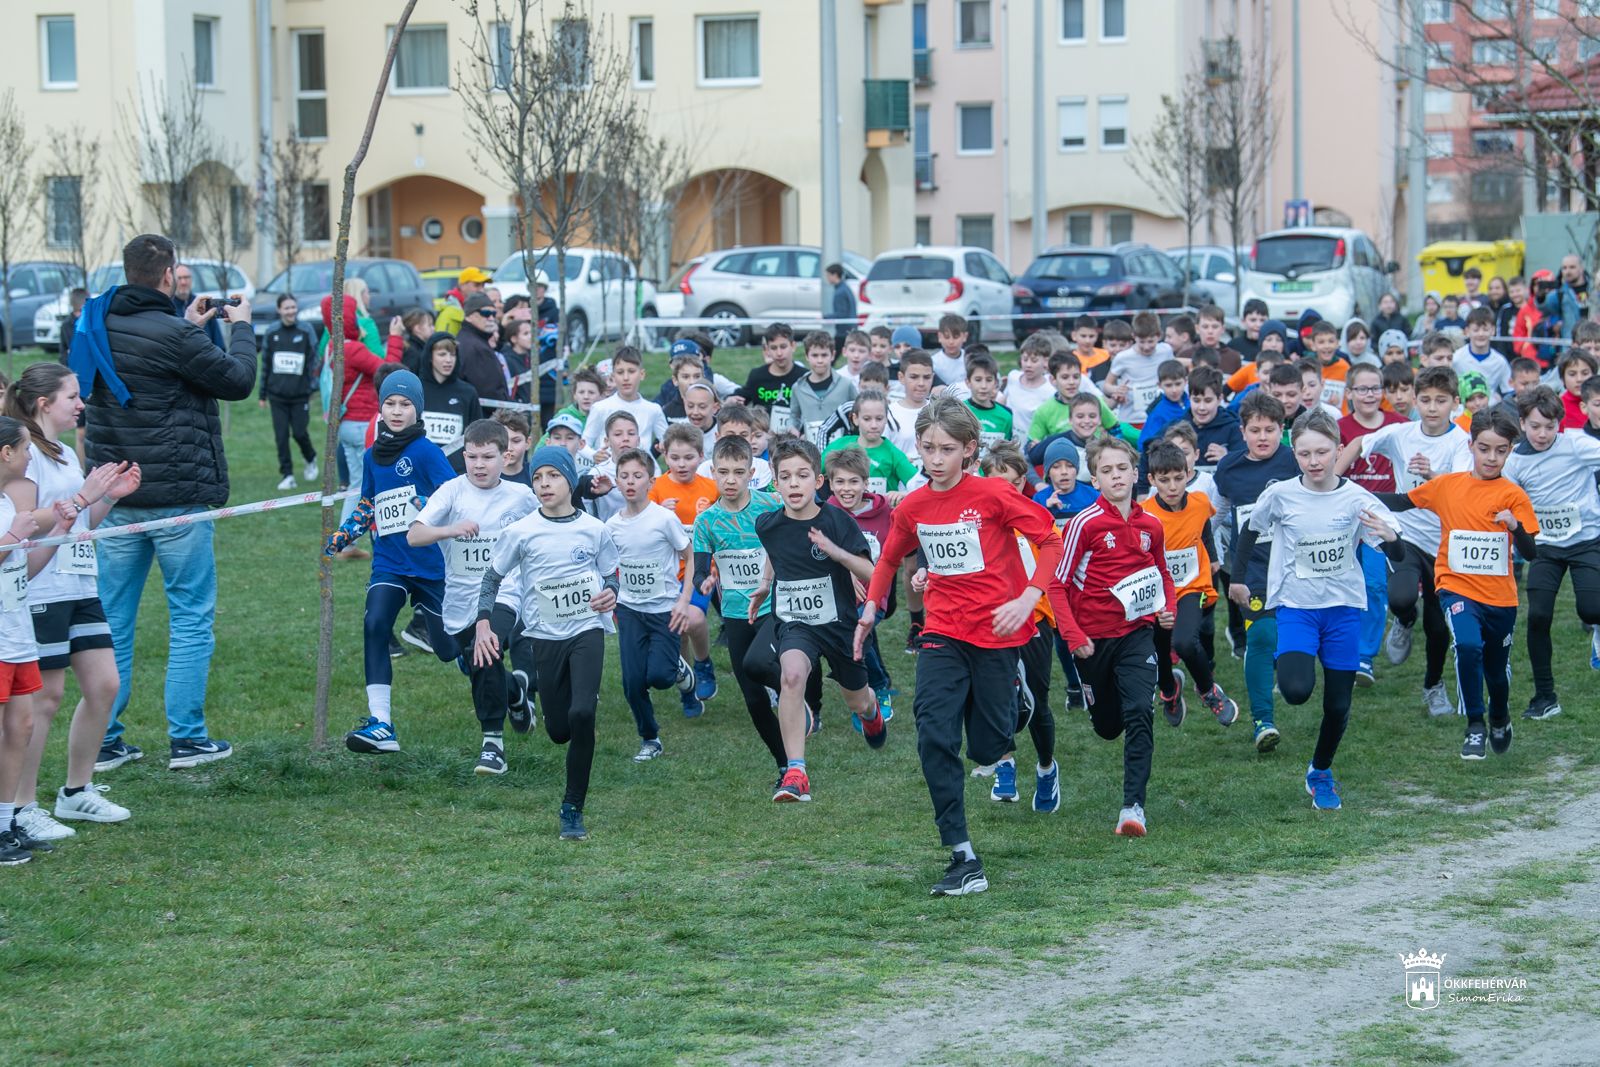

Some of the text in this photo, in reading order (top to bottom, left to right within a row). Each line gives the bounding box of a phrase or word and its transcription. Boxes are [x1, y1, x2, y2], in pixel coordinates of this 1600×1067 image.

[430, 423, 456, 434] 1148
[379, 503, 407, 521] 1087
[1539, 517, 1571, 530] 1053
[928, 542, 968, 559] 1063
[1308, 546, 1344, 564] 1082
[1461, 546, 1499, 560] 1075
[729, 563, 760, 576] 1108
[624, 573, 655, 585] 1085
[552, 589, 591, 608] 1105
[1132, 584, 1156, 602] 1056
[787, 595, 824, 611] 1106
